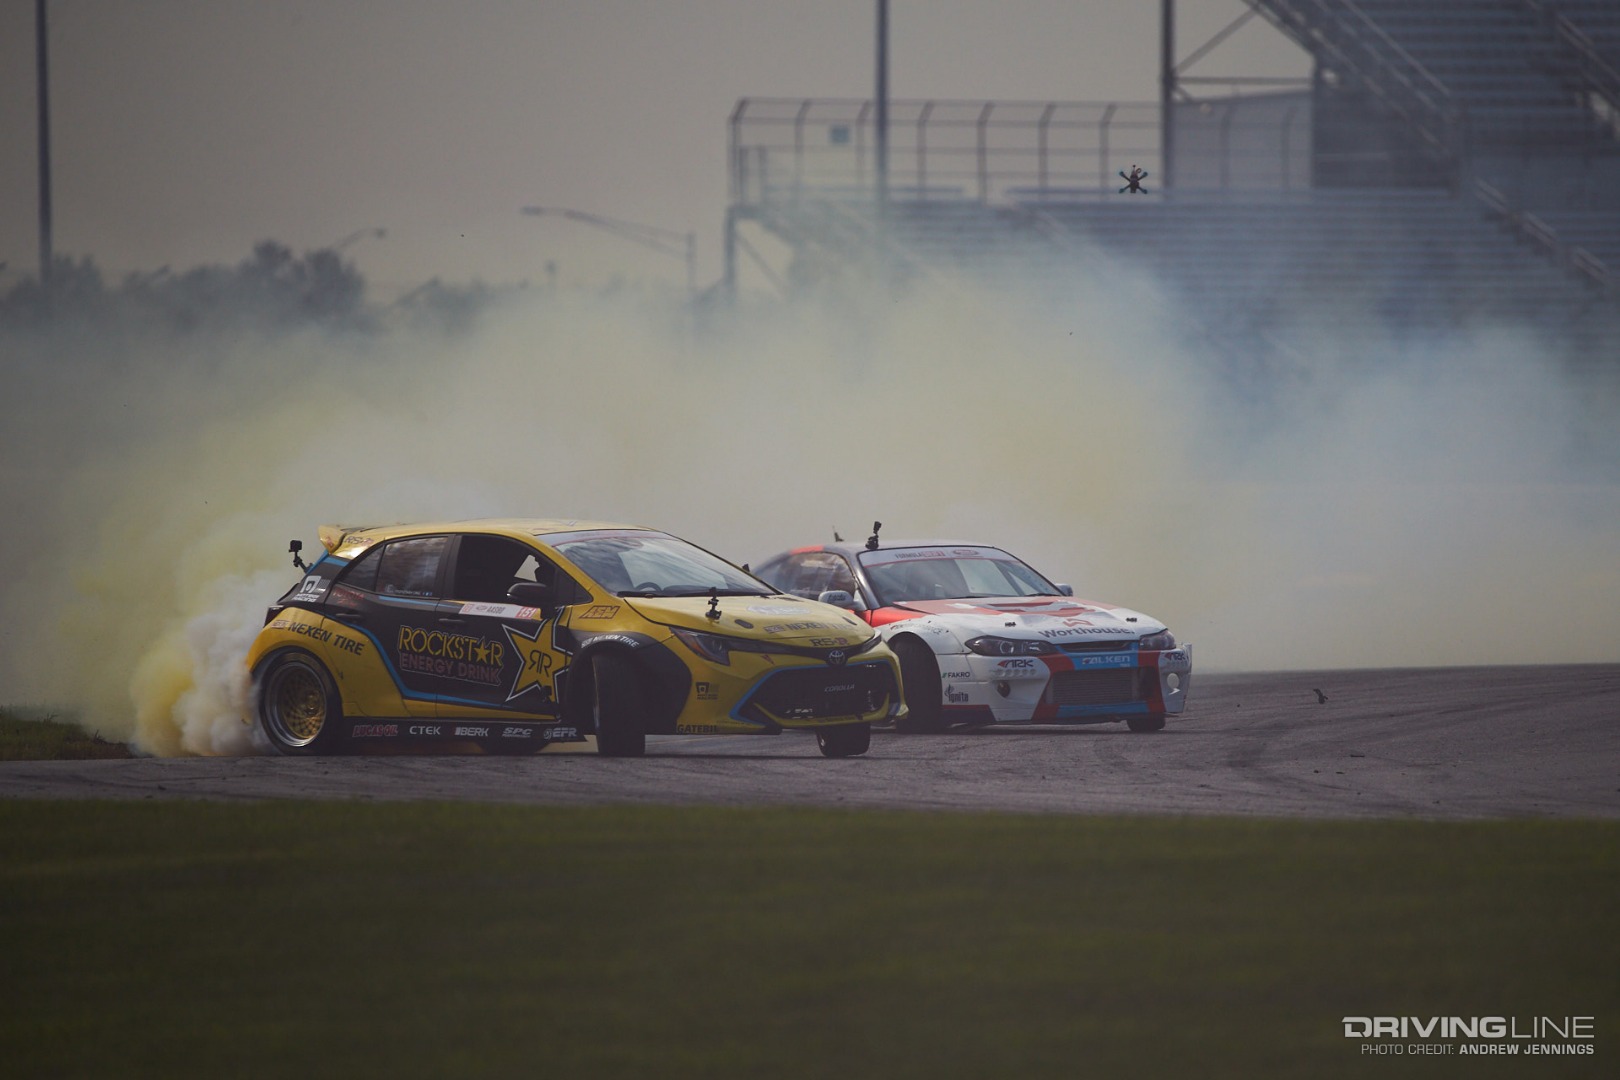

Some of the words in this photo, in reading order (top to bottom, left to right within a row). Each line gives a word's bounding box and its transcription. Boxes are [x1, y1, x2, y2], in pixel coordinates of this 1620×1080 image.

[518, 607, 536, 618] 151
[579, 606, 620, 619] AEM
[288, 622, 333, 642] NEXEN
[333, 635, 365, 656] TIRE
[620, 636, 640, 648] TIRE
[1082, 655, 1130, 665] FALKEN
[402, 654, 452, 677] ENERGY
[458, 664, 500, 684] DRINK
[824, 683, 855, 692] COROLLA
[352, 724, 383, 737] LUCAS
[409, 725, 441, 735] CTEK
[459, 727, 489, 737] BERK
[502, 727, 533, 735] SPC
[552, 727, 577, 738] EFR
